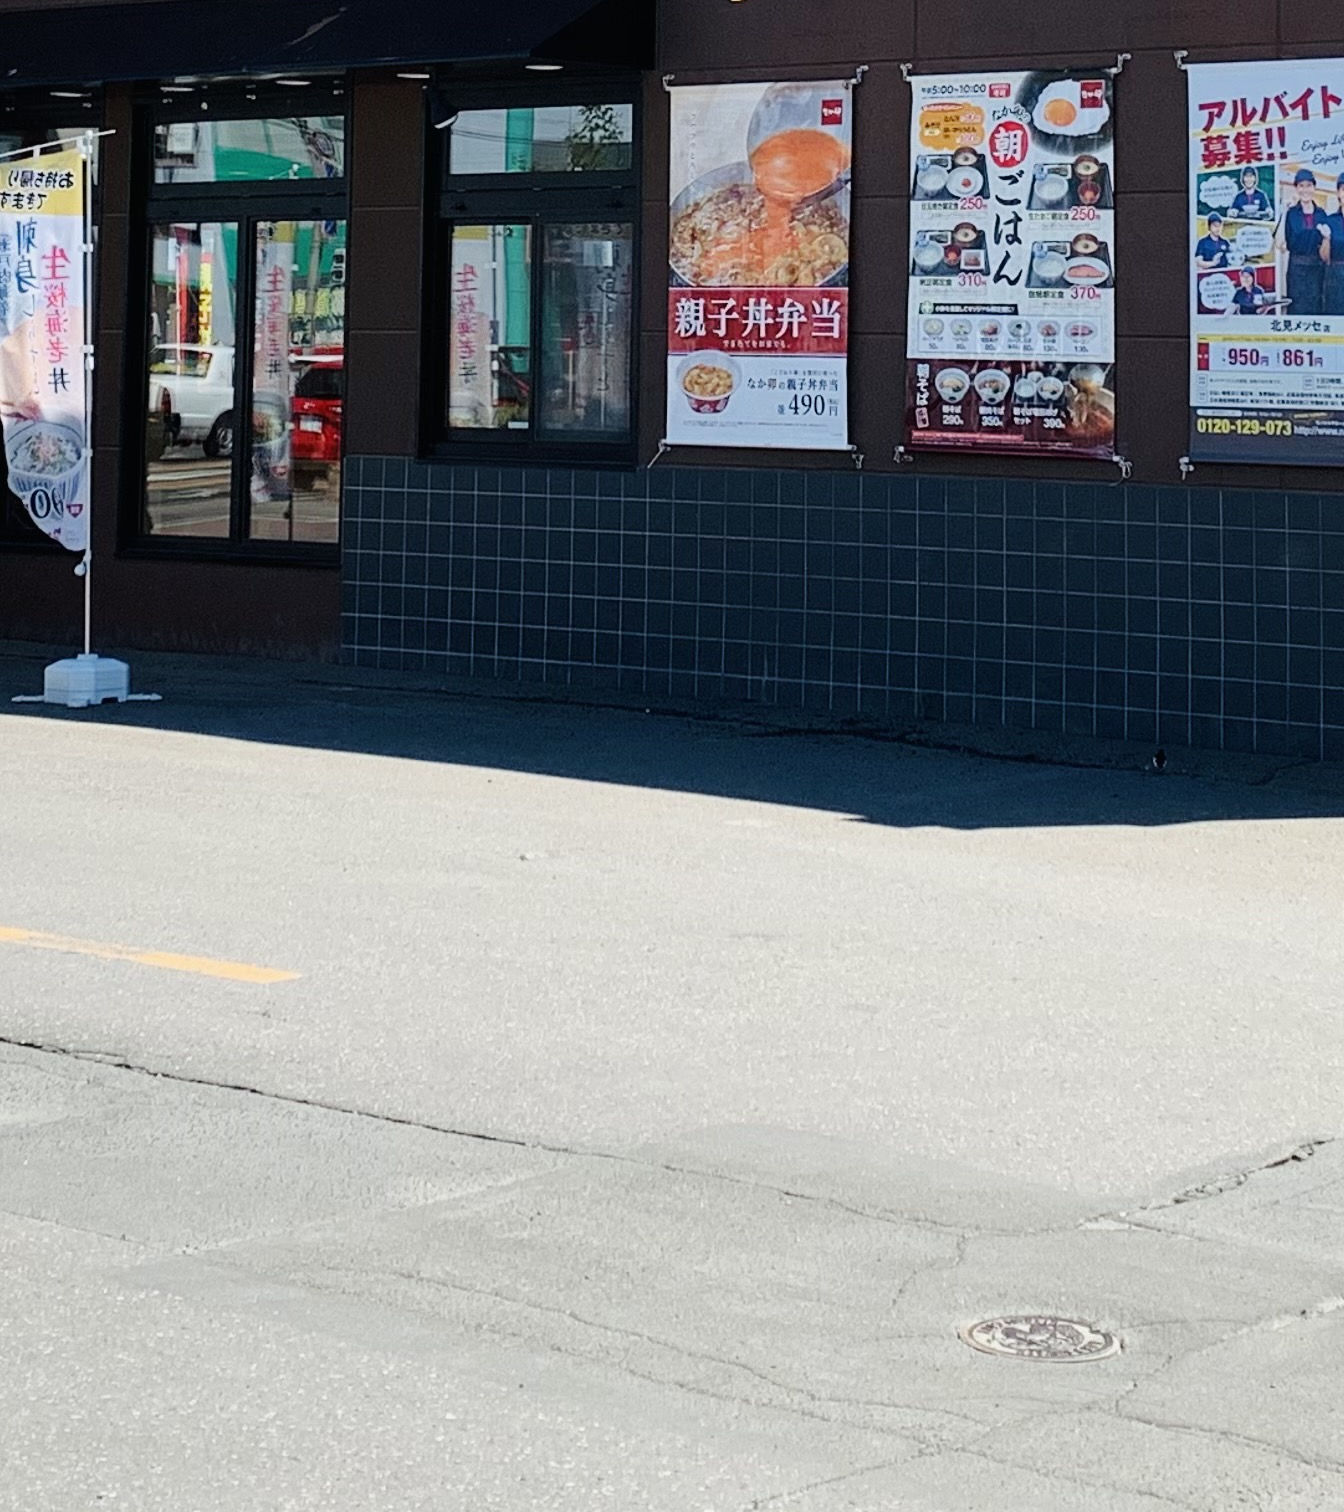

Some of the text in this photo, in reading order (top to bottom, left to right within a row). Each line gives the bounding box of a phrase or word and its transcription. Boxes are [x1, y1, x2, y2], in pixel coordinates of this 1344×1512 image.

[1198, 85, 1343, 133] アルバイト
[1301, 138, 1328, 153] Enjoy
[674, 297, 841, 338] 親子丼弁当
[1196, 417, 1292, 437] 0120-129-073
